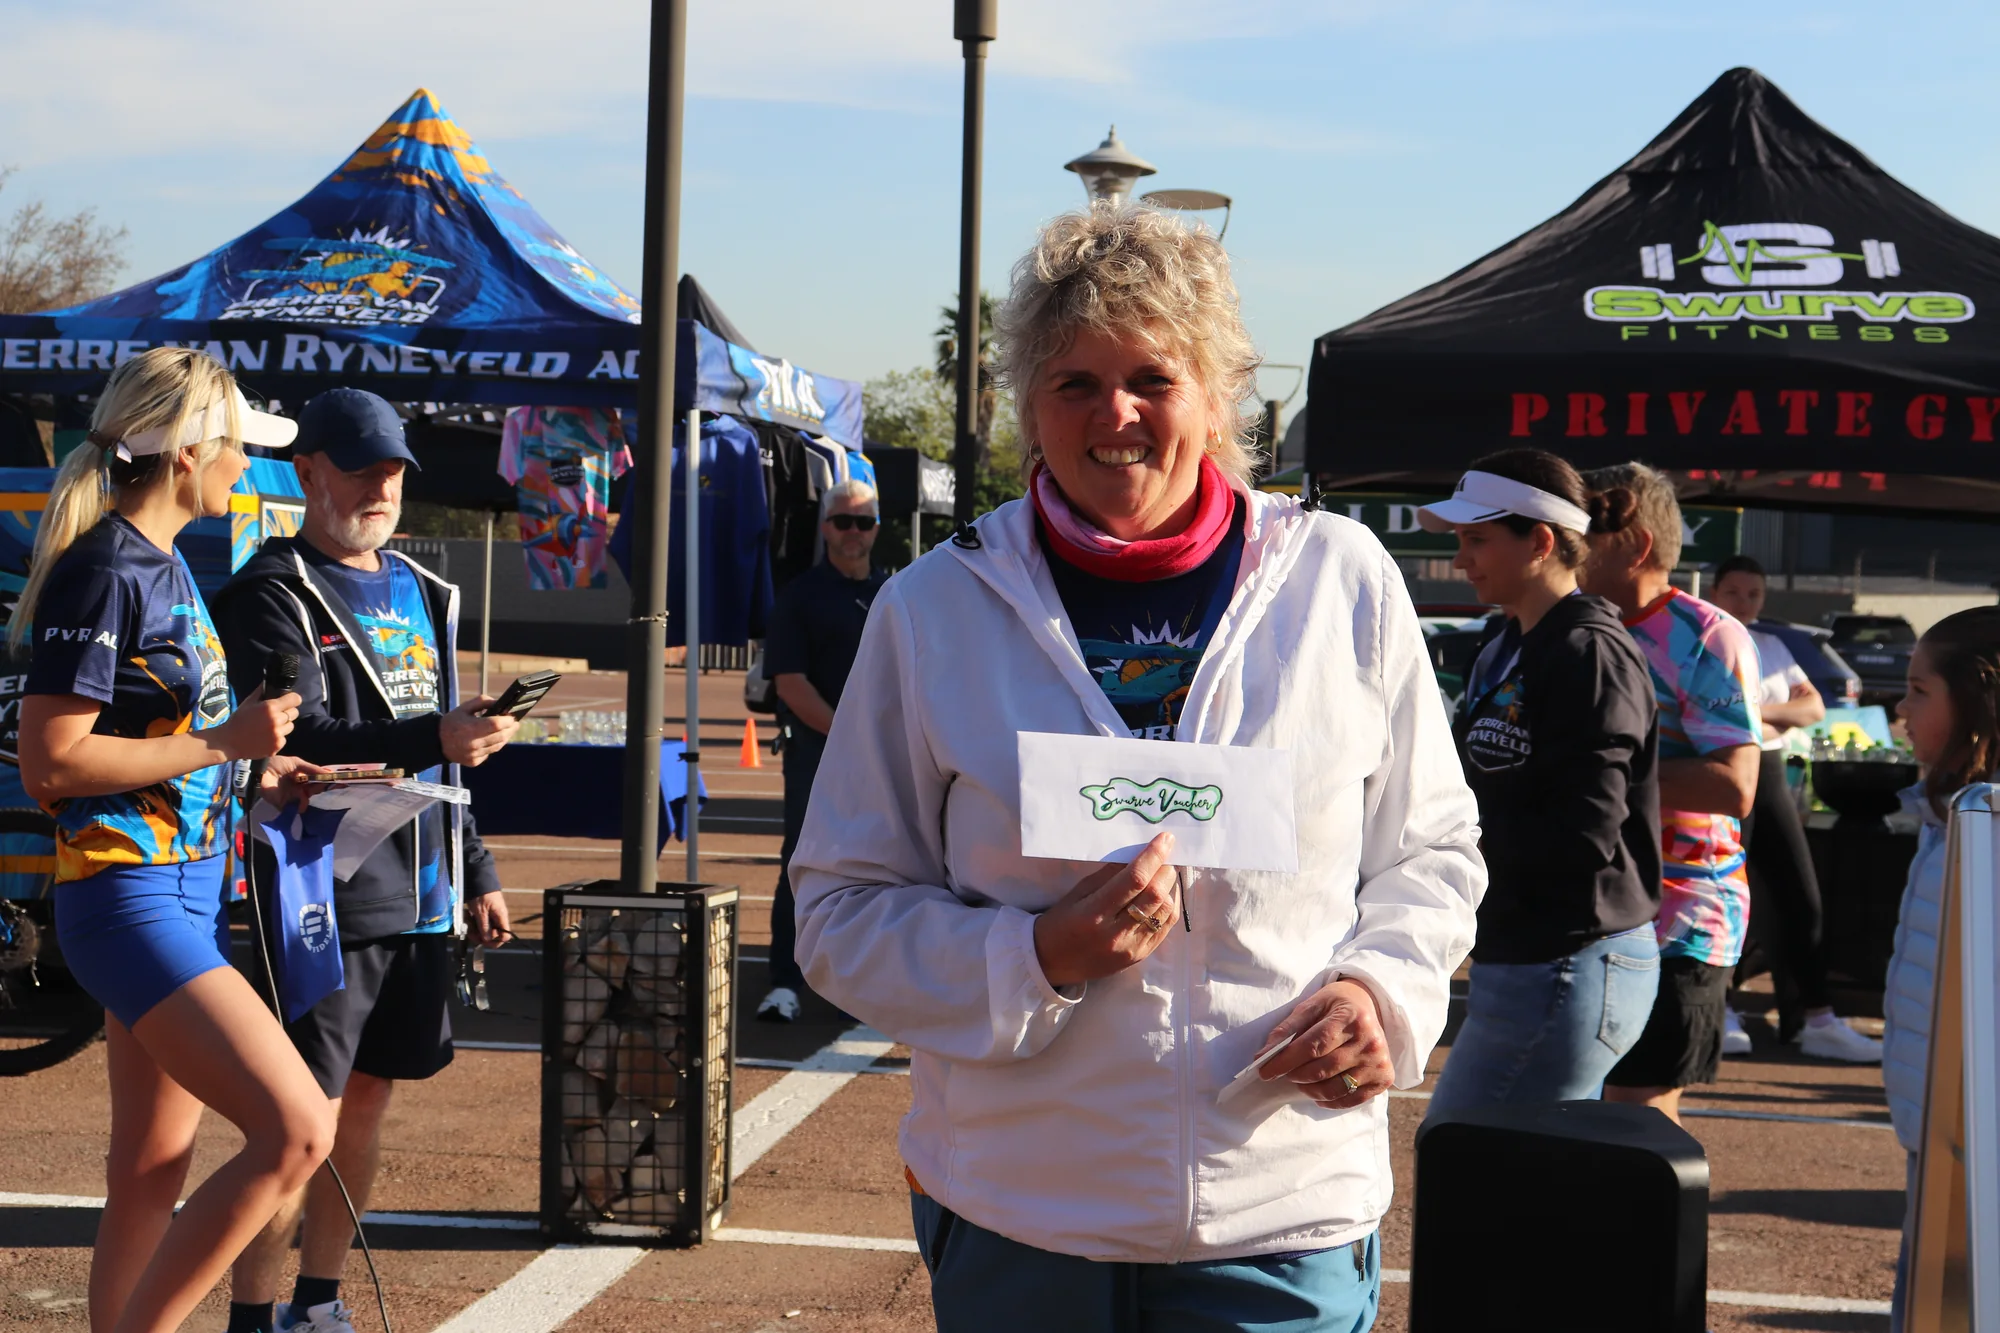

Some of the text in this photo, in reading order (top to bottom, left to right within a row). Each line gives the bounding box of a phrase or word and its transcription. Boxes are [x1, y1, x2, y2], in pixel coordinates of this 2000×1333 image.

[373, 296, 439, 315] VAN
[1588, 287, 1970, 321] Swurve
[1621, 325, 1950, 342] FITNESS
[0, 338, 150, 369] ERRE
[281, 334, 570, 379] RYNEVELD
[1510, 390, 2000, 443] PRIVATE GY
[44, 627, 93, 642] PVR
[1100, 786, 1213, 812] Swurve Voucher
